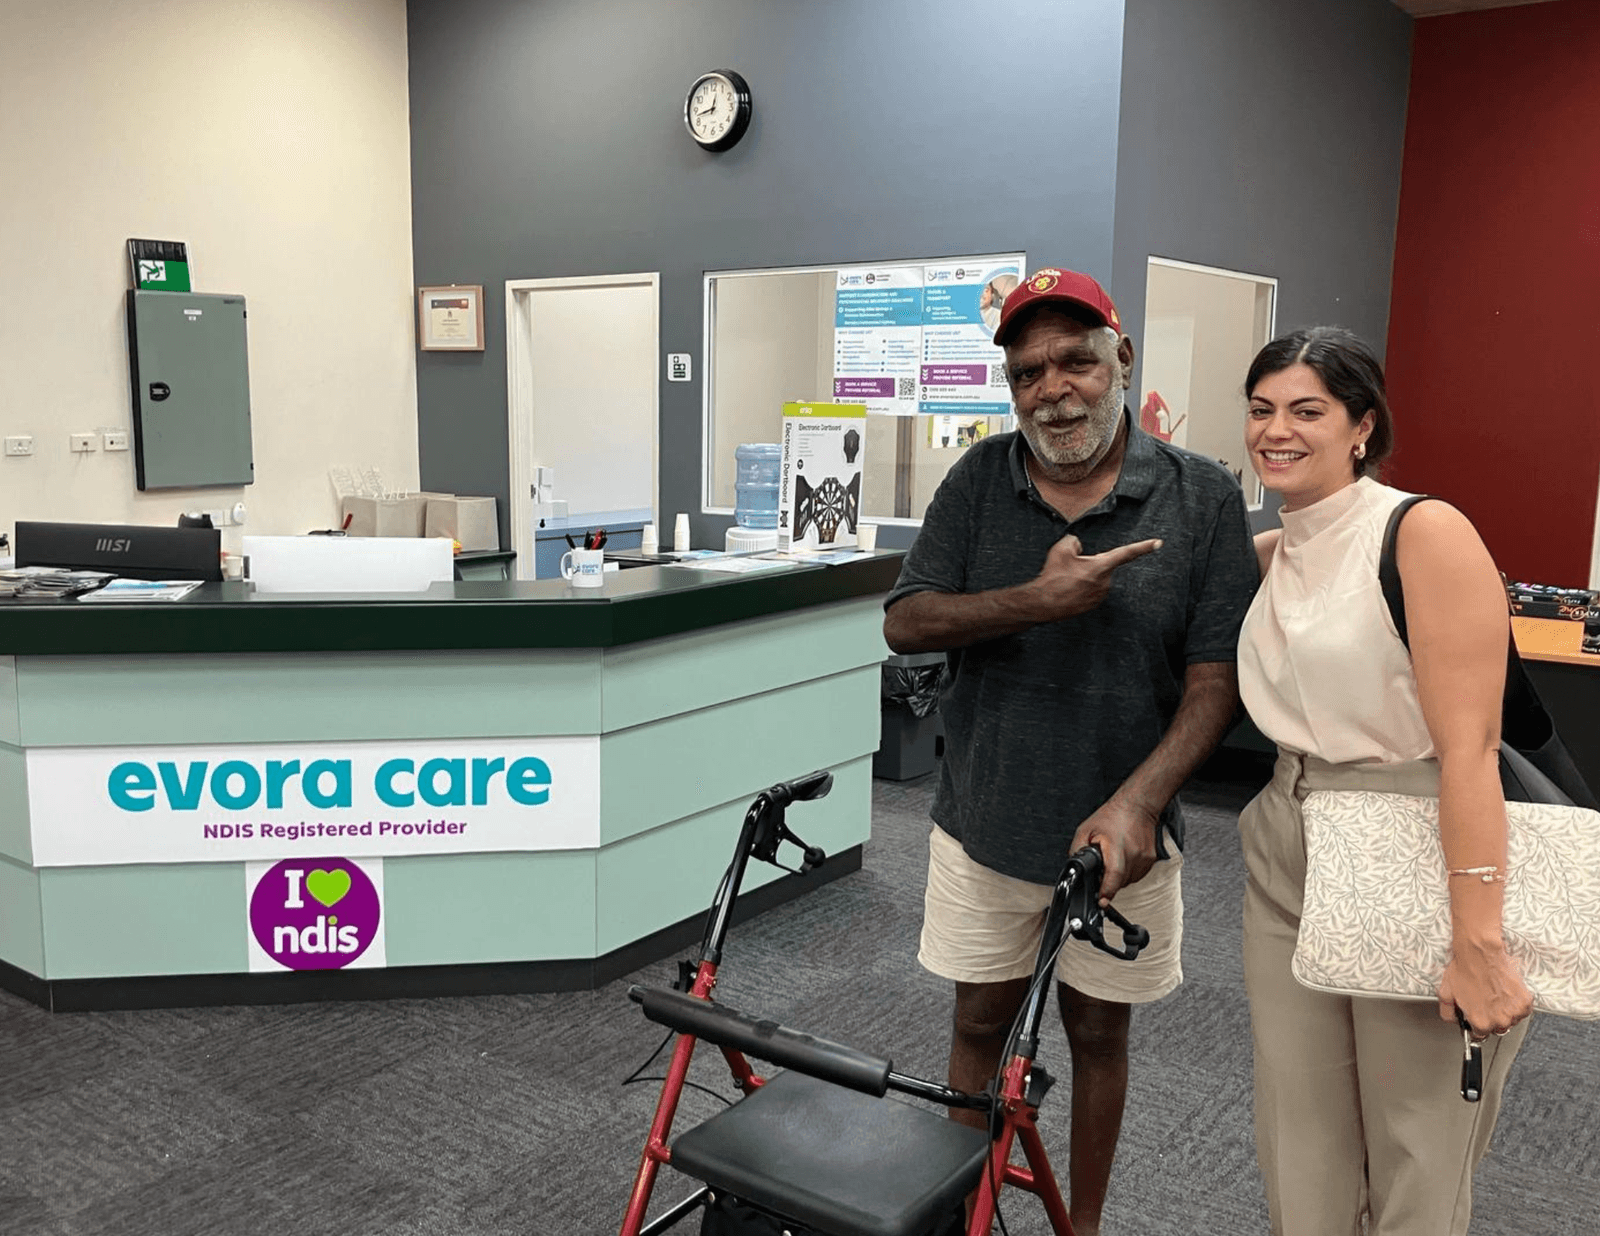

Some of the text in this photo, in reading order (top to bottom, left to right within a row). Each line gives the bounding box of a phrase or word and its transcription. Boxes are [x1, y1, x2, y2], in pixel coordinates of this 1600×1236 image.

[704, 86, 709, 95] 11
[711, 82, 717, 92] 12
[695, 95, 703, 104] 10
[727, 92, 732, 101] 2
[693, 107, 698, 115] 9
[729, 103, 734, 111] 3
[696, 118, 701, 126] 8
[702, 125, 707, 133] 7
[711, 126, 716, 135] 6
[720, 123, 724, 132] 5
[799, 423, 820, 431] Electronic
[782, 463, 790, 504] Dartboard
[108, 756, 552, 812] evora care
[203, 820, 467, 841] NDIS Registered Provider
[284, 869, 304, 908] I
[274, 915, 359, 954] ndis
